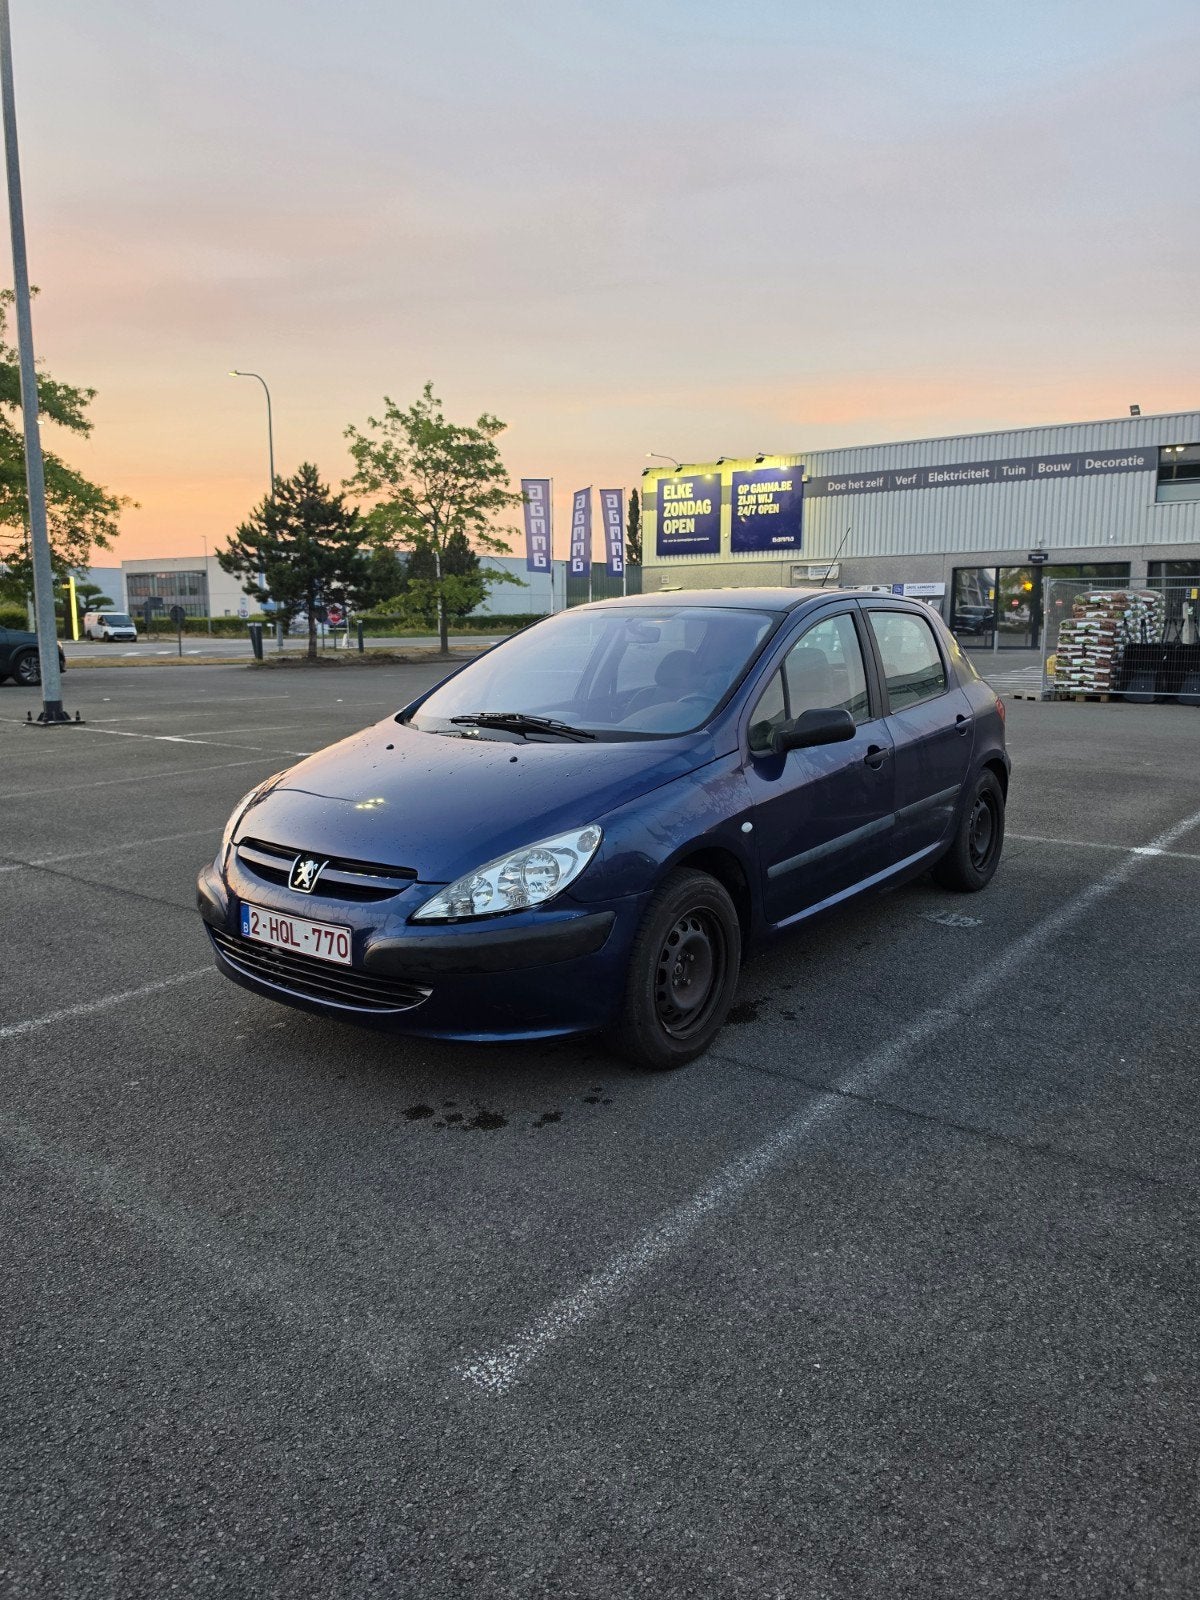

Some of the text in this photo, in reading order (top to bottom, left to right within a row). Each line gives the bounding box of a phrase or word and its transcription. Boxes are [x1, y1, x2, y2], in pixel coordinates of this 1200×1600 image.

[827, 455, 1144, 492] Doe het zelf Verf Elektriciteit Tuin Bouw Decoratie
[663, 482, 693, 500] ELKE
[738, 480, 793, 495] OP GAMMA.BE
[738, 493, 773, 505] ZIJN WIJ
[663, 499, 712, 518] ZONDAG
[737, 503, 780, 516] 24/7 OPEN
[663, 517, 695, 535] OPEN
[243, 911, 348, 958] B 2-HQL-770
